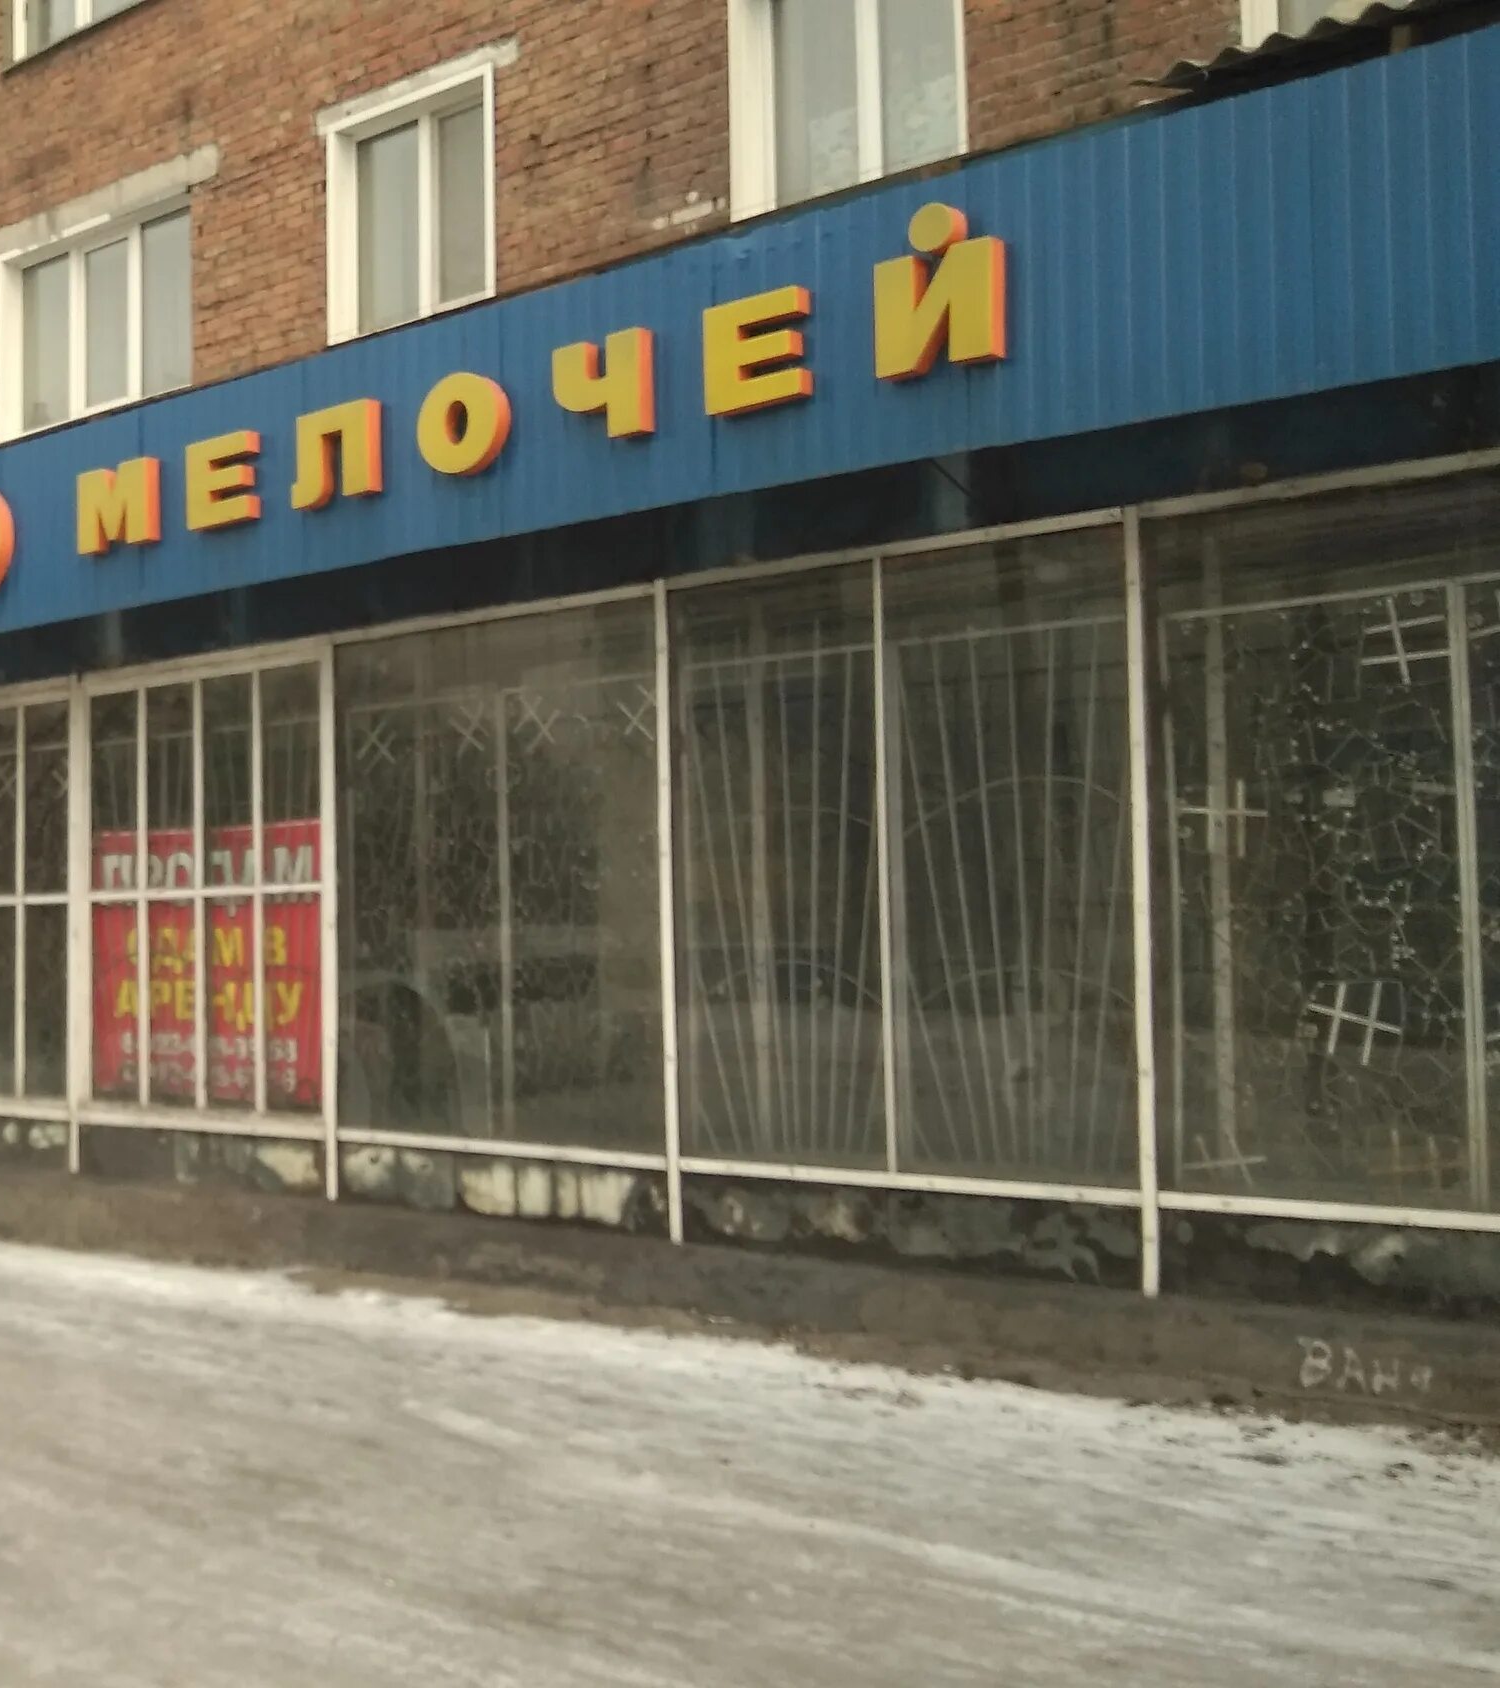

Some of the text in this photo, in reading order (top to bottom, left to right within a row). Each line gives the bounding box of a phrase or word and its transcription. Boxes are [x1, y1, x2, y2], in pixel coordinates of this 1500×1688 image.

[76, 202, 1006, 556] МЕЛОЧЕЙ
[262, 924, 288, 966] В
[114, 978, 304, 1032] АРЕНДУ
